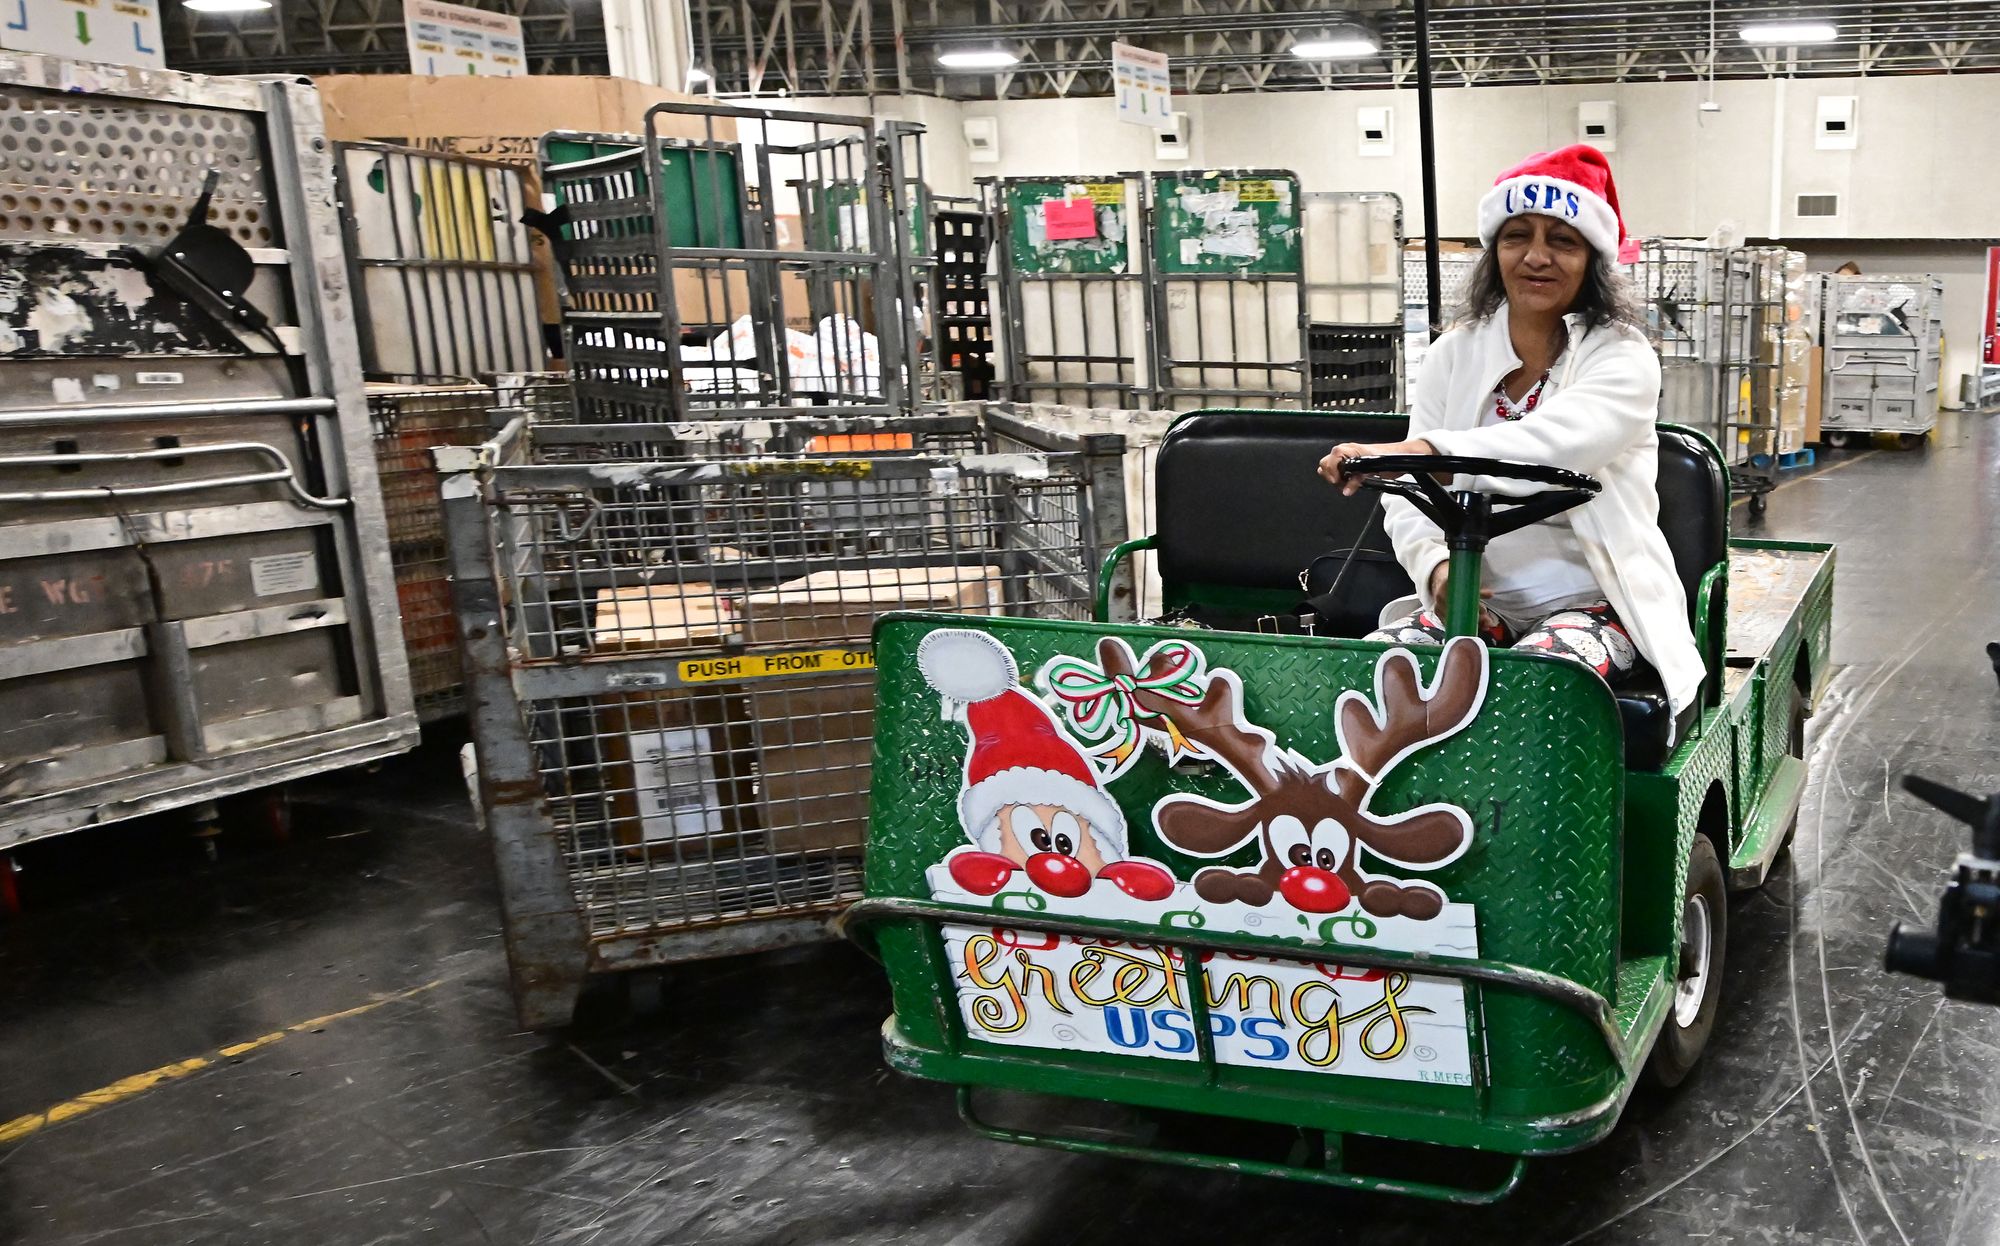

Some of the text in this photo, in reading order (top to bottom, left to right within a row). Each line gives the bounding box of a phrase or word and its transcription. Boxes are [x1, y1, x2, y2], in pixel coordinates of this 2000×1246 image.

[1505, 183, 1580, 218] USPS
[687, 660, 741, 678] PUSH
[765, 654, 820, 671] FROM
[1103, 1006, 1290, 1061] USPS
